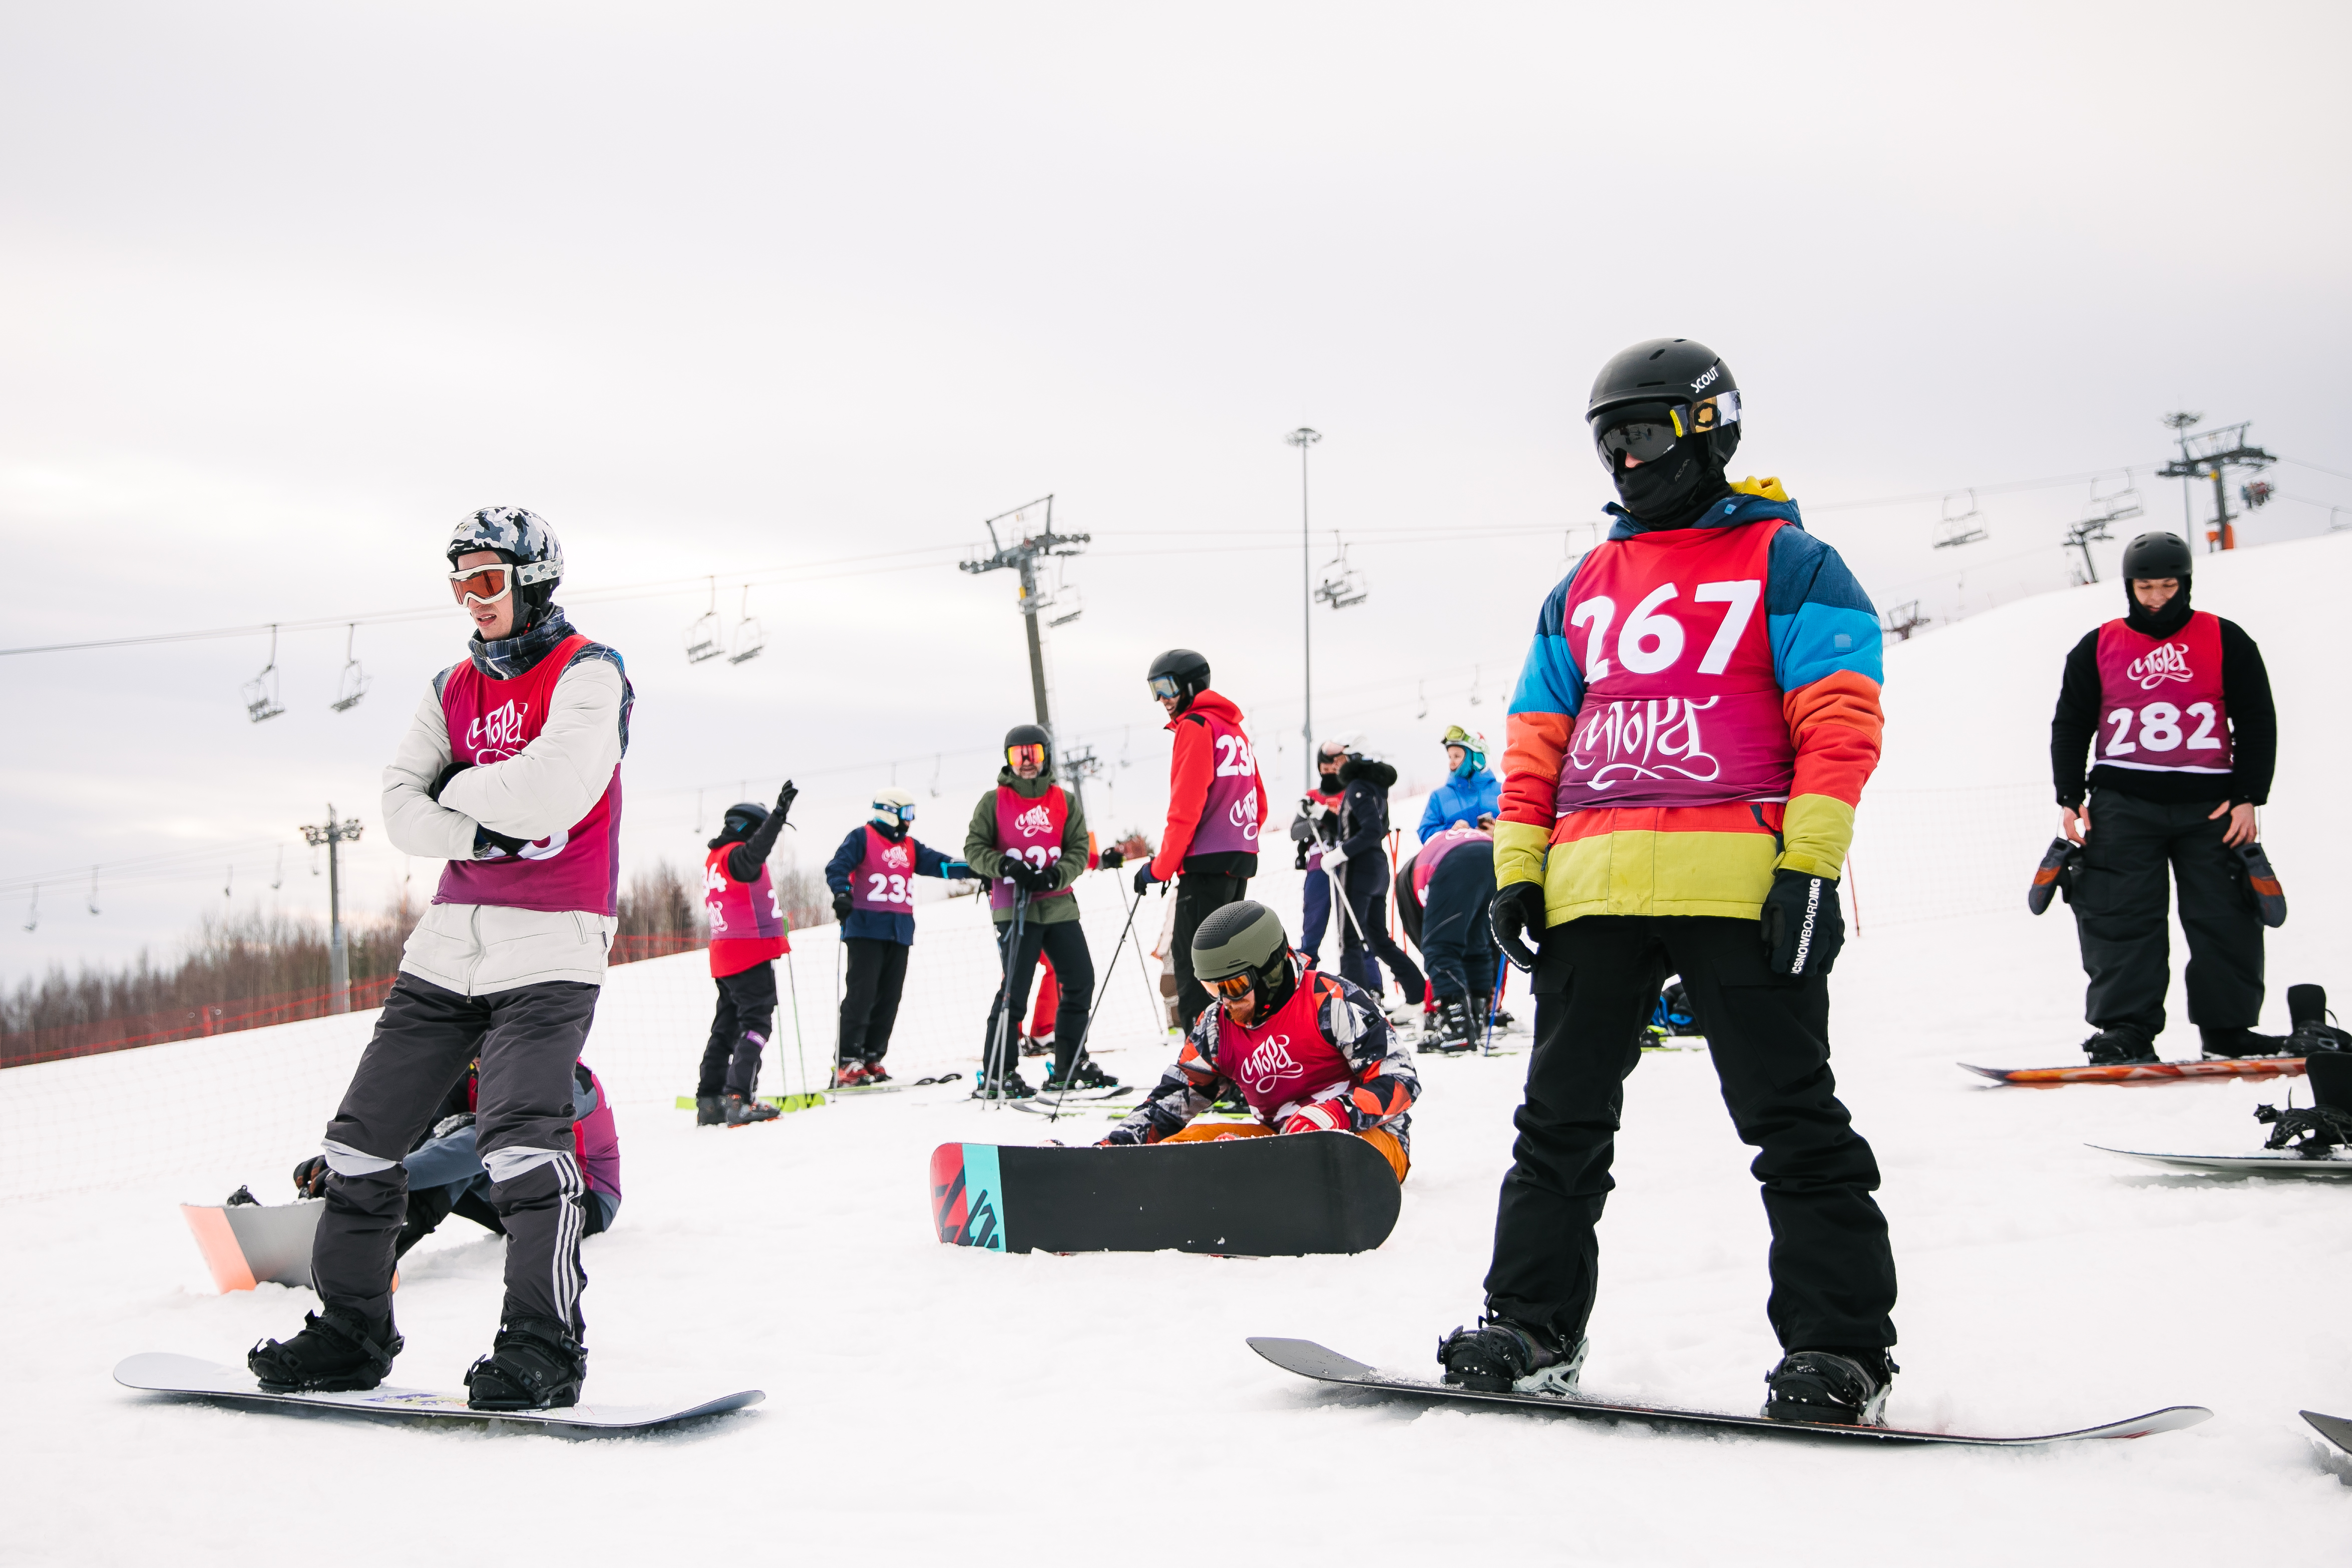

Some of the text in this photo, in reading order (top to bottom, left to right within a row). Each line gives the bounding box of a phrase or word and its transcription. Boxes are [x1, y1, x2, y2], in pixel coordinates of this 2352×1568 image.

[1690, 366, 1719, 394] SCOUT
[1571, 579, 1761, 685] 267
[2105, 701, 2222, 756] 282
